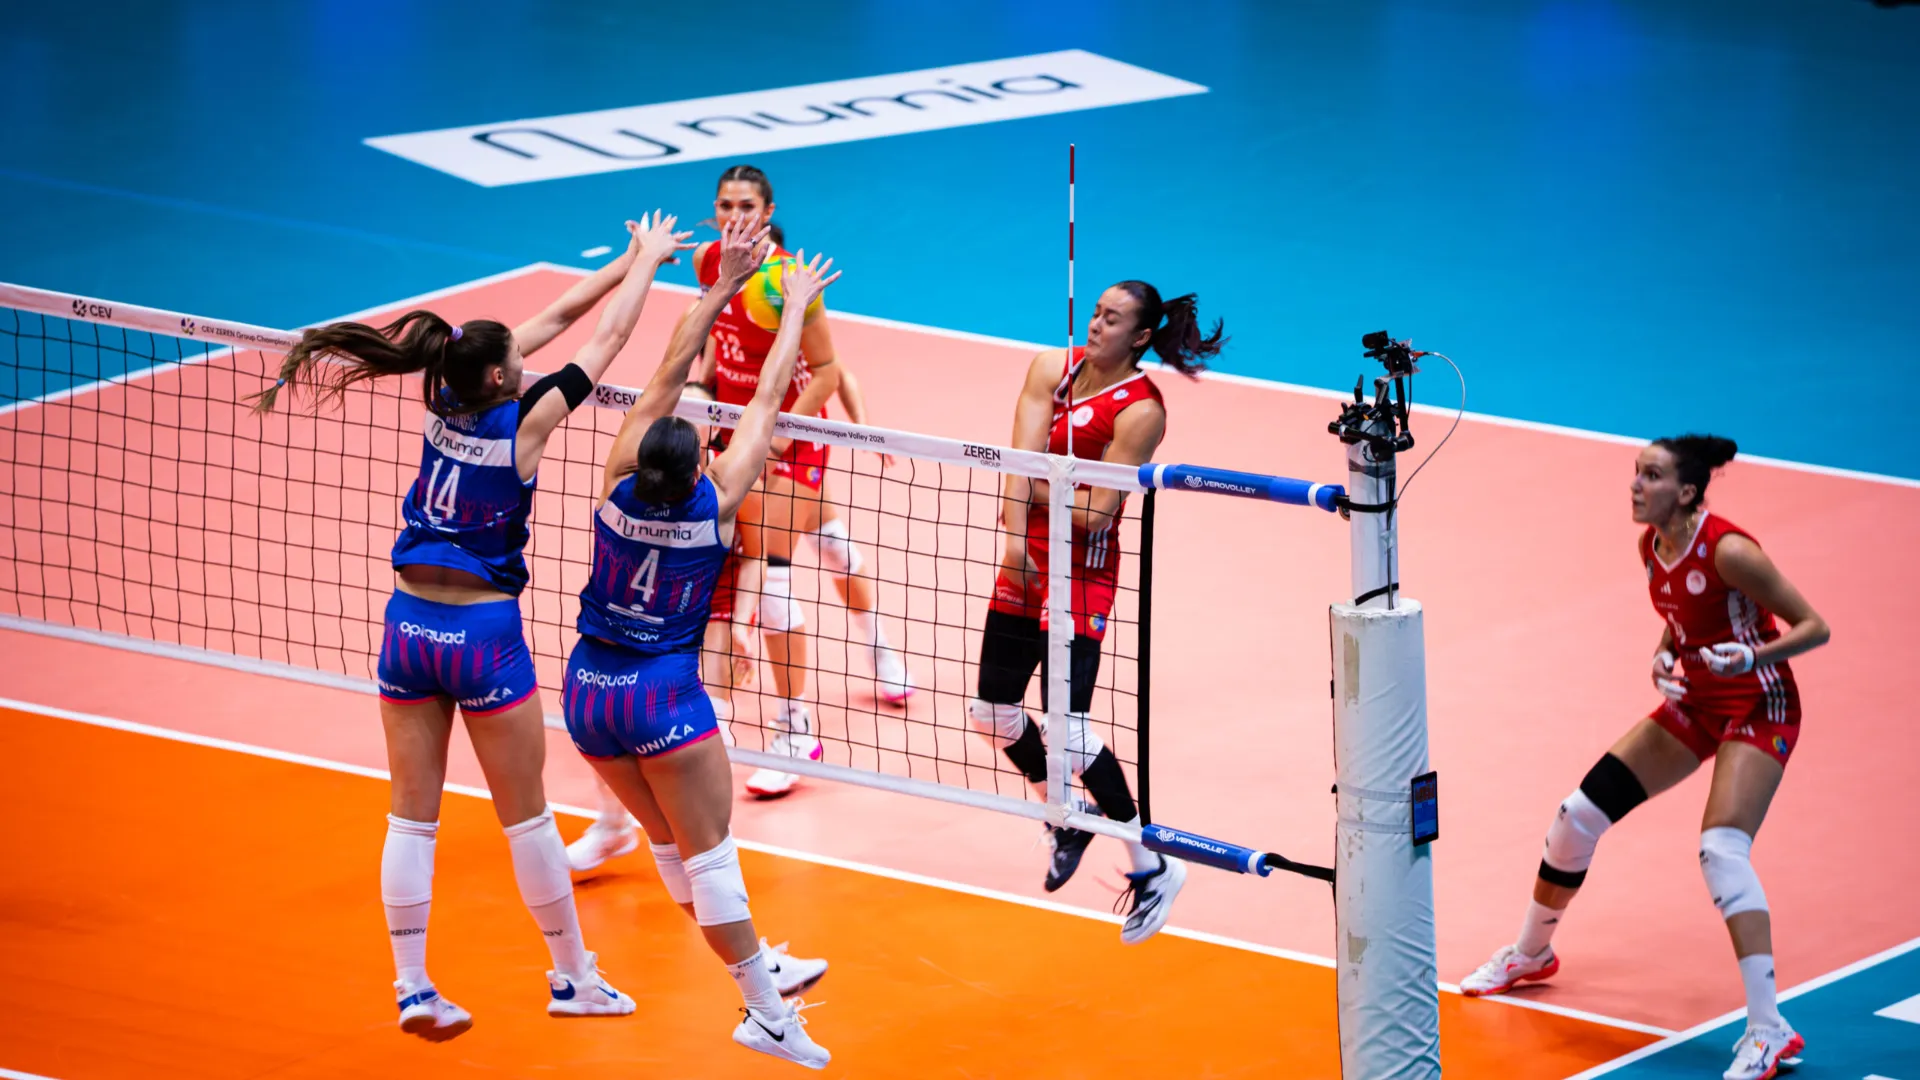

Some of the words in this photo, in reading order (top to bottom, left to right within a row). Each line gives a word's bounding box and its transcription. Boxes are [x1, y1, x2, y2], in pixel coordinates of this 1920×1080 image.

[675, 73, 1083, 136] numia
[89, 304, 112, 319] CEV
[201, 325, 214, 334] CEV
[215, 327, 236, 339] ZEREN
[236, 331, 257, 342] Group
[256, 334, 292, 347] Champions
[613, 391, 637, 406] CEV
[787, 421, 823, 434] Champions
[823, 427, 848, 440] League
[848, 430, 868, 443] Volley
[868, 434, 886, 445] 2026
[962, 444, 1001, 461] ZEREN
[980, 459, 1001, 469] GROUP
[423, 457, 461, 521] 14
[1203, 479, 1256, 494] VEROVOLLEY
[638, 525, 692, 541] numia
[630, 548, 660, 603] 4
[400, 621, 466, 646] opiquad
[576, 668, 639, 690] opiquad
[635, 723, 695, 755] UNIKA
[1175, 835, 1229, 855] VEROVOLLEY
